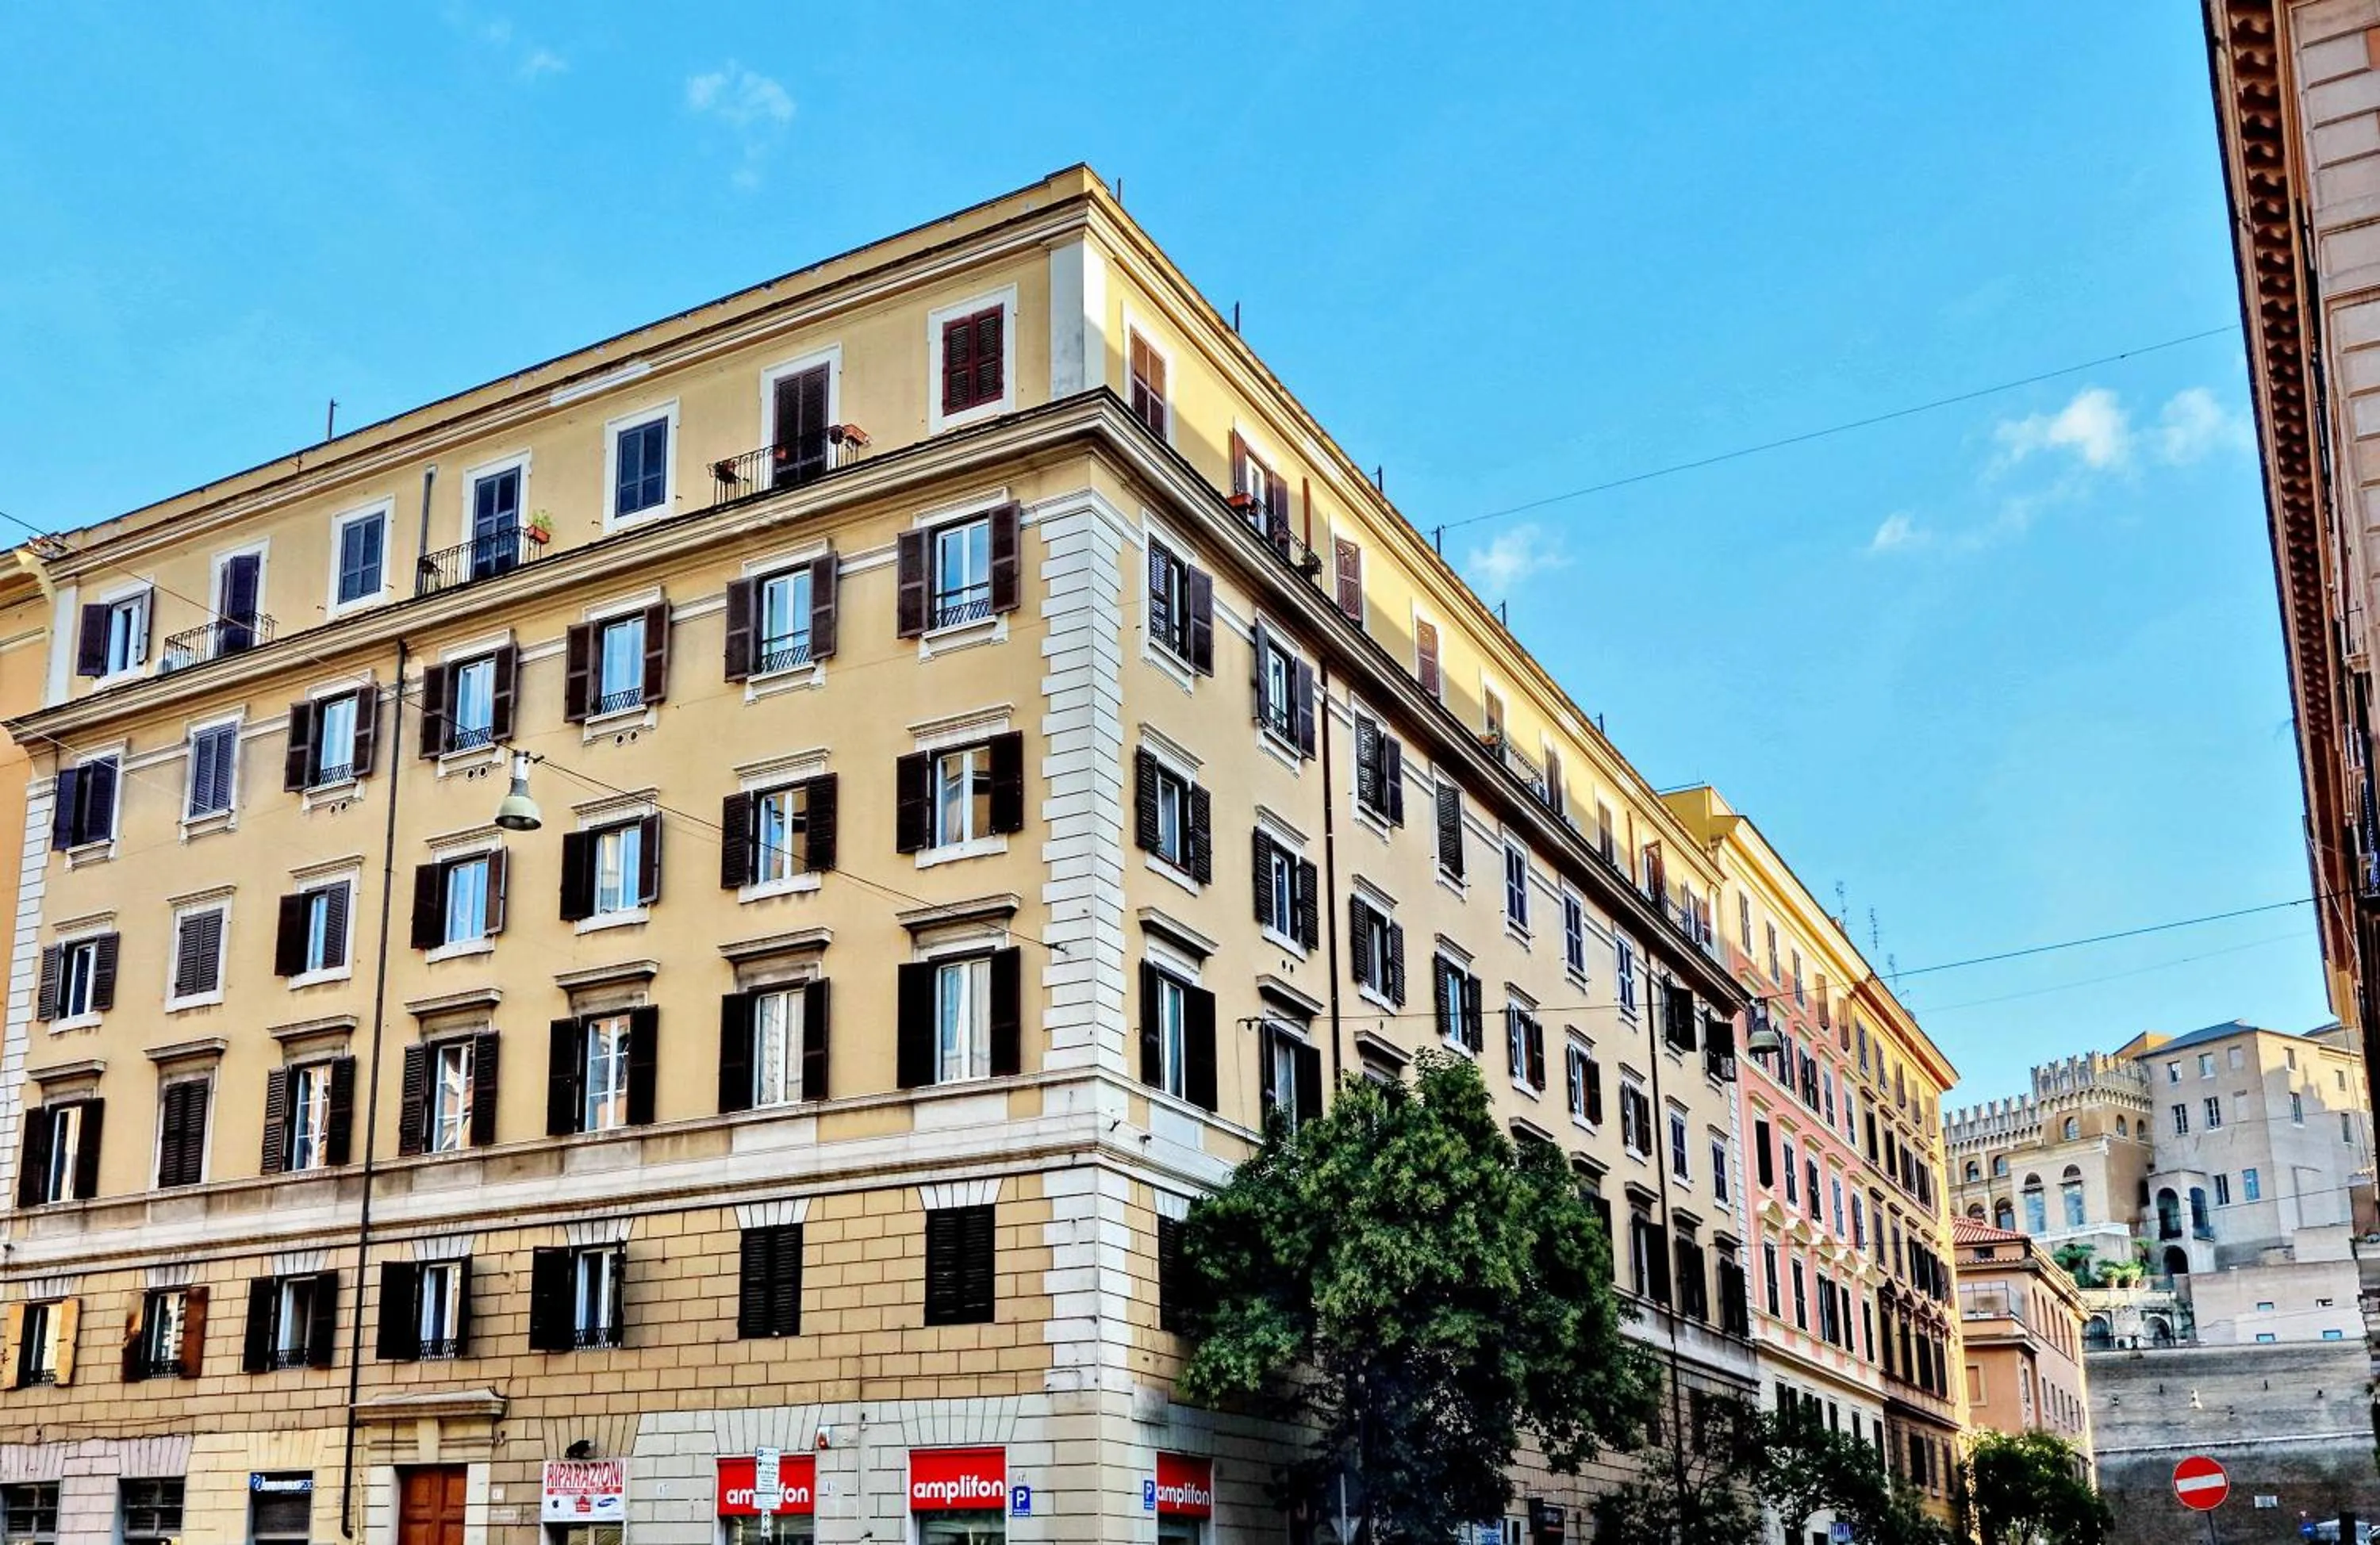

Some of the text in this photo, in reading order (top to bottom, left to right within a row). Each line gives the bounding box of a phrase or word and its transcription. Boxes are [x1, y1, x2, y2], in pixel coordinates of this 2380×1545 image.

[547, 1461, 623, 1487] RIPARAZIONI
[726, 1482, 809, 1505] amfon
[913, 1474, 1004, 1505] amplifon
[1016, 1489, 1027, 1508] P
[1146, 1482, 1153, 1500] P
[1157, 1482, 1210, 1509] amplifon
